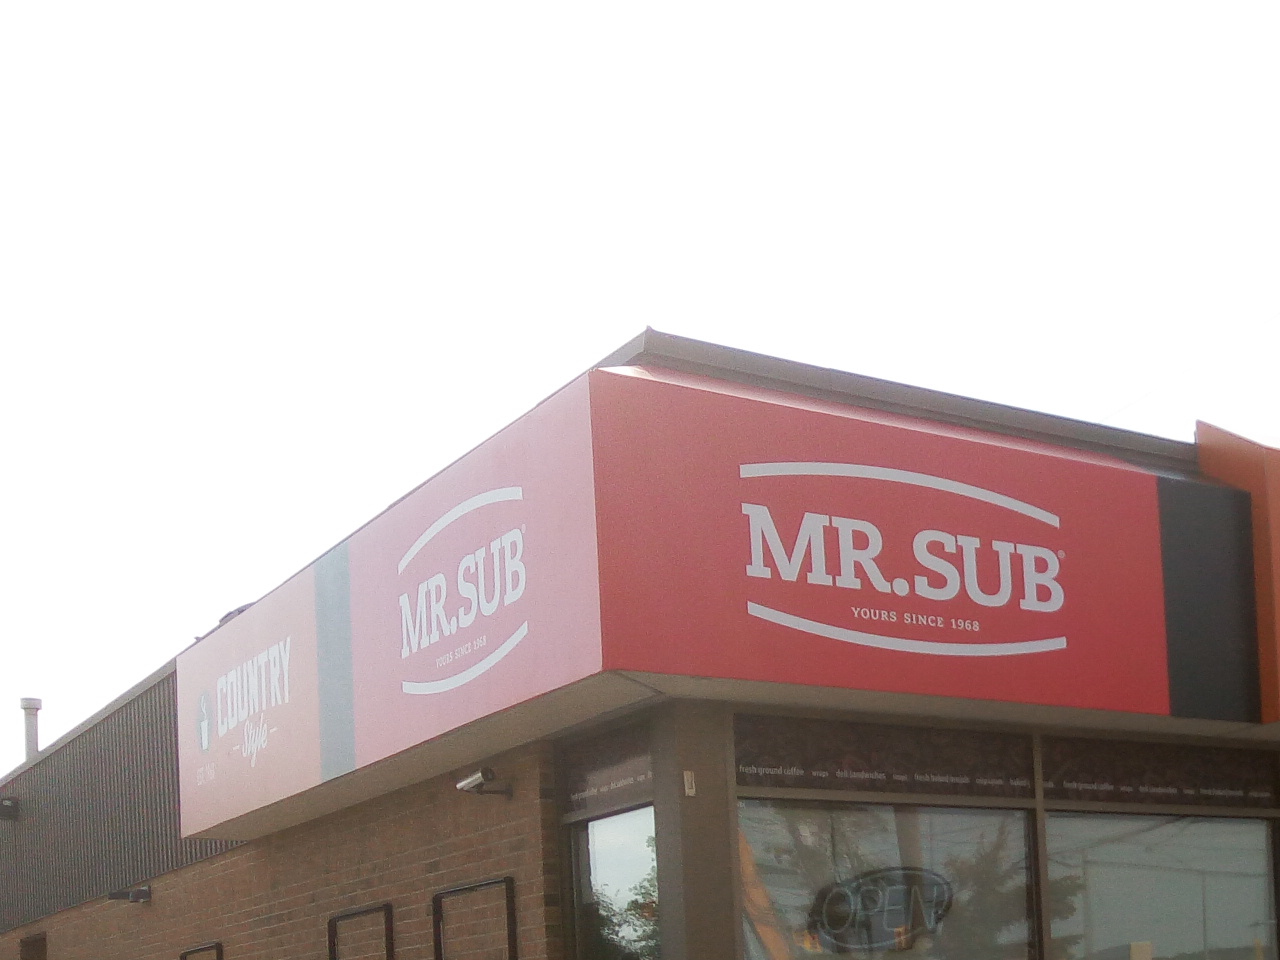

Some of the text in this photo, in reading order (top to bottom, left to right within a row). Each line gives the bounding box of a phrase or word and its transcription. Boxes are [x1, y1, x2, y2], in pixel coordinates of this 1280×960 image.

[741, 502, 1065, 613] MR.SUB
[398, 529, 526, 659] MR.SUB
[851, 606, 981, 632] YOURS SINCE 1968
[435, 635, 487, 668] YOURS SINCE 1968
[217, 636, 291, 738] COUNTRY
[242, 712, 268, 768] Style
[739, 765, 757, 773] fresh
[758, 766, 783, 777] ground
[784, 767, 805, 776] coffee
[822, 884, 938, 933] OPEN
